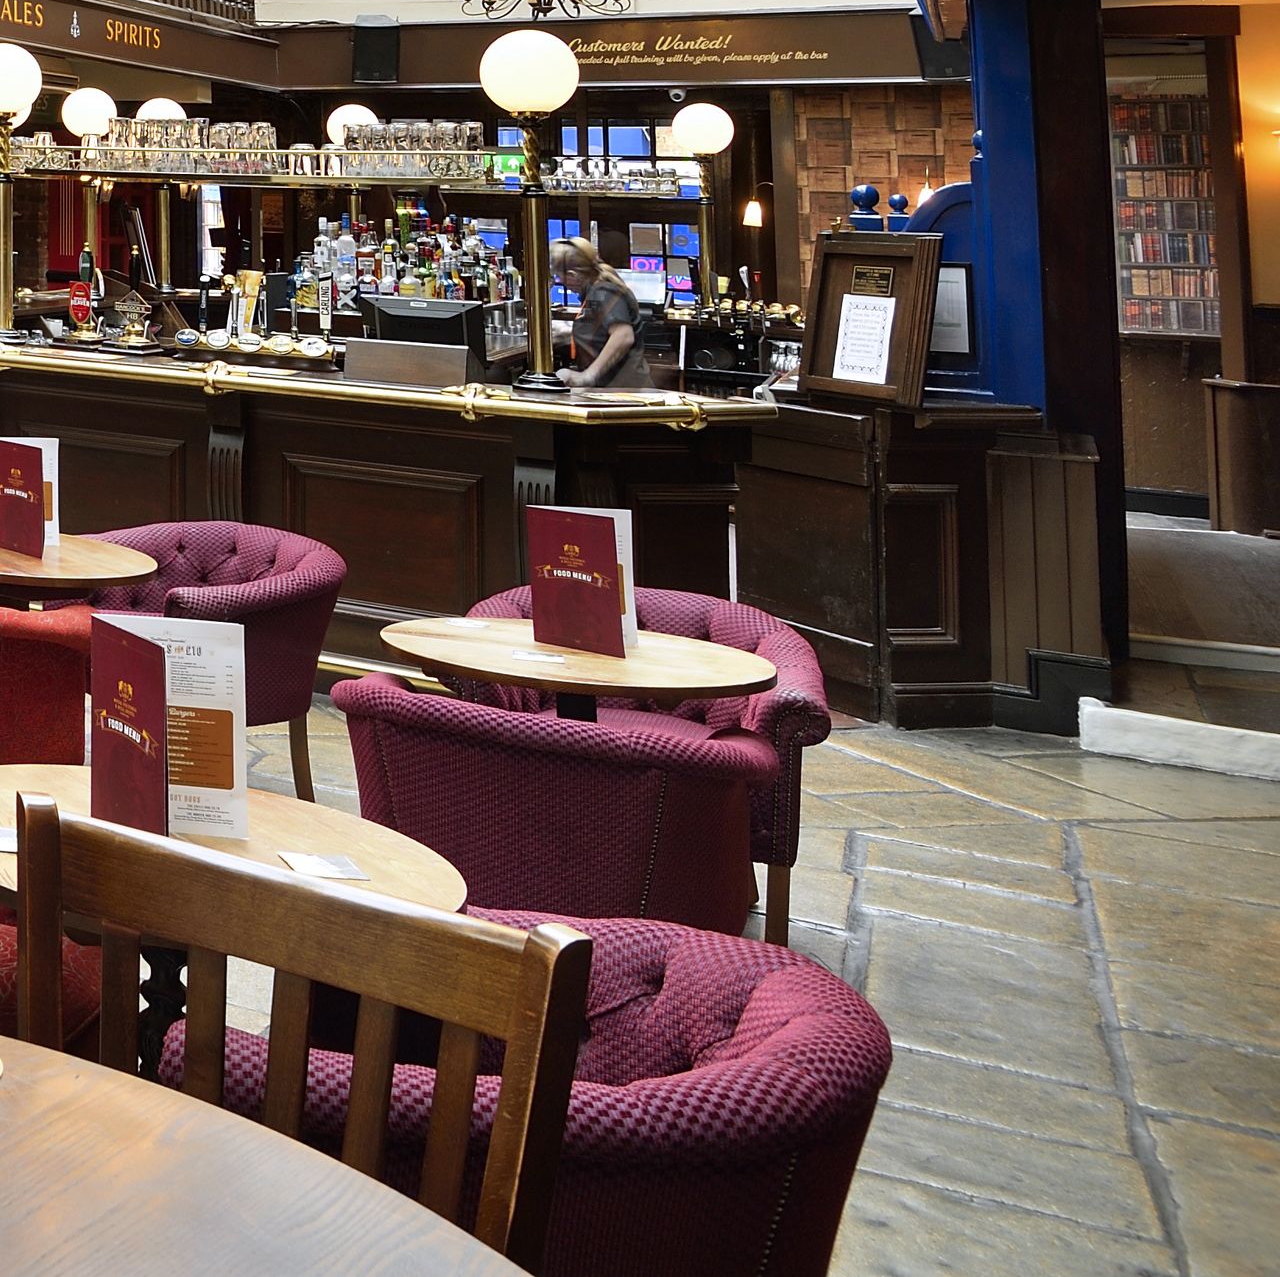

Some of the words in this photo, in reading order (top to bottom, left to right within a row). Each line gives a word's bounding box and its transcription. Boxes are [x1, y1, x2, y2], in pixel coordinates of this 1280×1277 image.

[105, 18, 162, 50] SPIRITS
[569, 38, 646, 53] Customers
[655, 34, 733, 51] Wanted!
[604, 57, 614, 65] as
[613, 55, 630, 66] full
[630, 54, 664, 66] training
[666, 53, 683, 63] will
[684, 53, 694, 63] be
[693, 53, 721, 65] given,
[723, 52, 752, 64] please
[753, 51, 780, 64] apply
[780, 51, 794, 60] at
[794, 50, 809, 60] the
[810, 50, 829, 60] bar
[321, 285, 330, 316] CARLING
[553, 569, 571, 578] FOOD
[572, 572, 592, 582] MENU
[108, 718, 124, 733] FOOD
[123, 723, 141, 744] MENU
